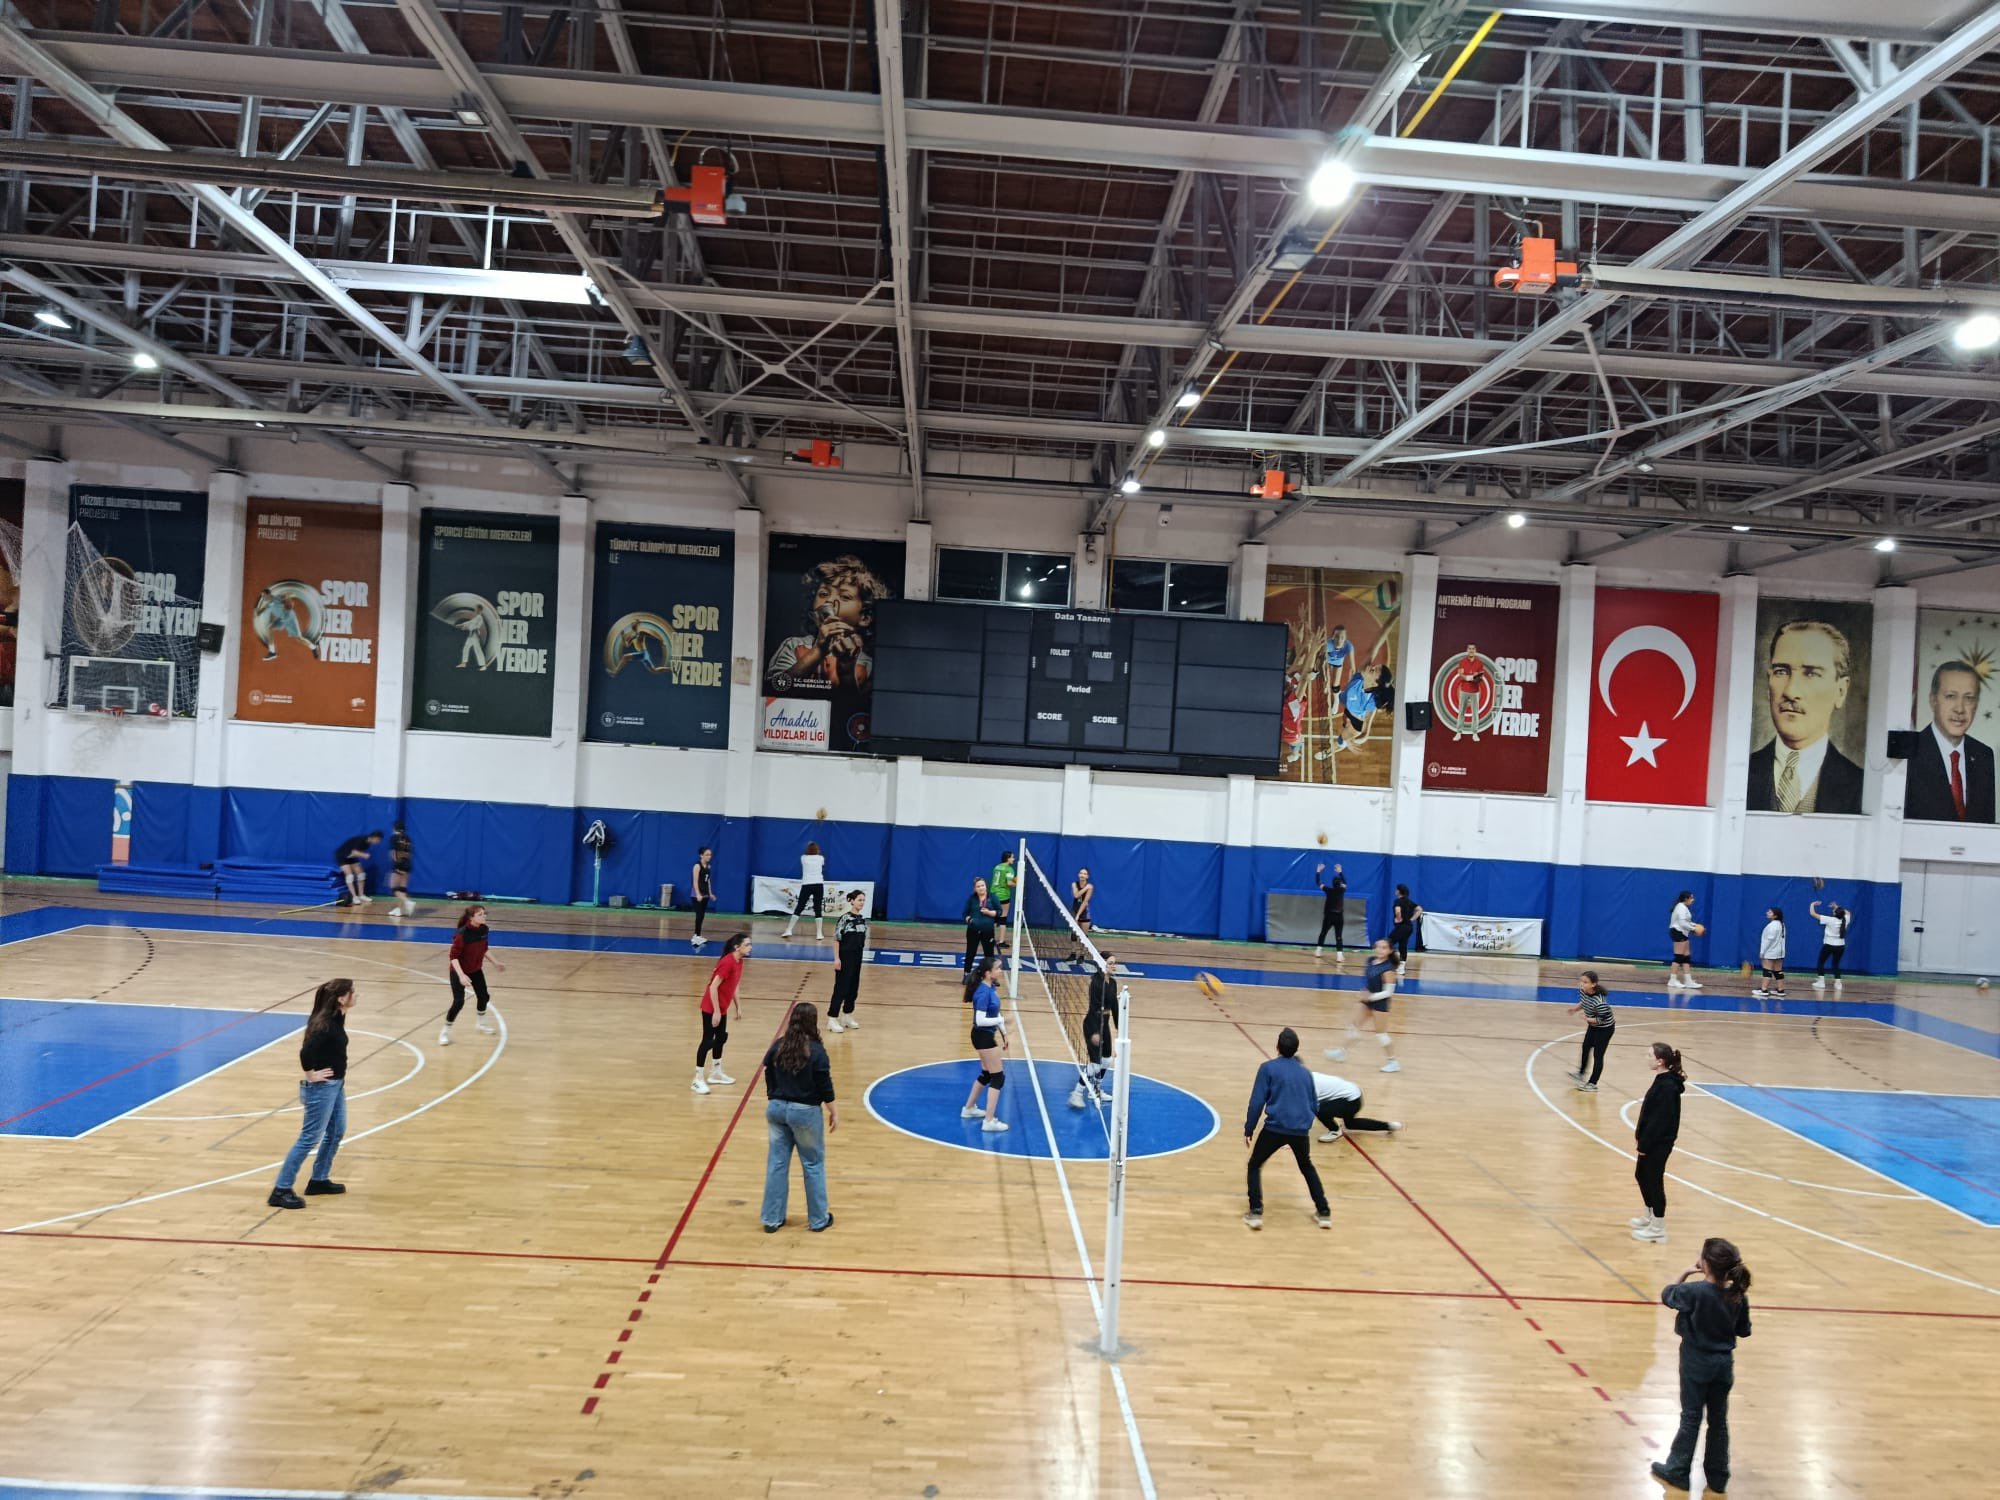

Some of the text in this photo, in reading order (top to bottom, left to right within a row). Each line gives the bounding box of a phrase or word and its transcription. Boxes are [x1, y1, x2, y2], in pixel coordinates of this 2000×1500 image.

[610, 538, 639, 551] TÜRKİYE
[320, 579, 369, 607] SPOR
[497, 590, 545, 618] SPOR
[1438, 594, 1532, 610] ANTRENÖR EĞİTİM PROGRAMI
[164, 606, 202, 637] YER
[321, 608, 353, 635] HER
[672, 603, 720, 631] SPOR
[1054, 612, 1075, 621] Data
[498, 618, 529, 645] HER
[671, 631, 704, 658] HER
[318, 636, 372, 664] YERDE
[496, 646, 548, 674] YERDE
[671, 659, 723, 687] YERDE
[1494, 656, 1538, 683] SPOR
[1066, 684, 1092, 694] Period
[770, 708, 818, 728] Anadolu
[1037, 711, 1063, 720] SCORE
[1092, 715, 1118, 724] SCORE
[1491, 711, 1540, 737] YERDE
[764, 728, 808, 741] YILDIZLARI
